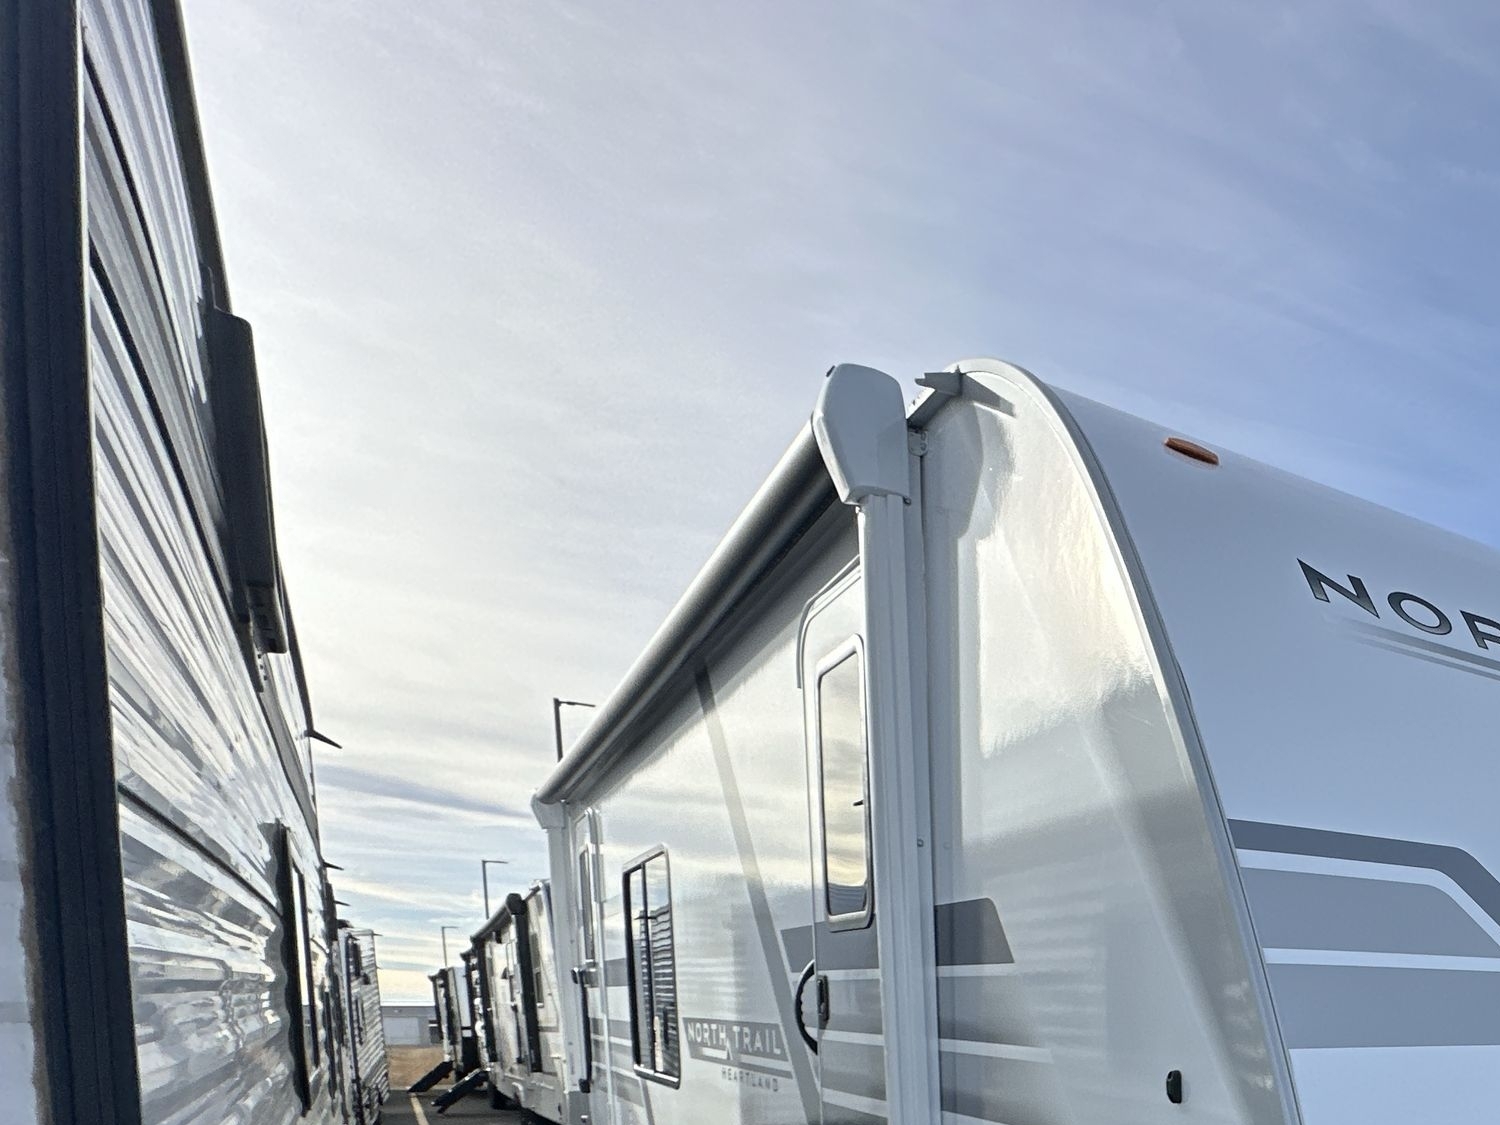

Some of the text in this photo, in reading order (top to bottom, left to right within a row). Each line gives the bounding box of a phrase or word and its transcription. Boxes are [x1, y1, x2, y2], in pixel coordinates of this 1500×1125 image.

[688, 1022, 781, 1053] NORTH TRAIL
[721, 1067, 779, 1092] HEARTLAND
